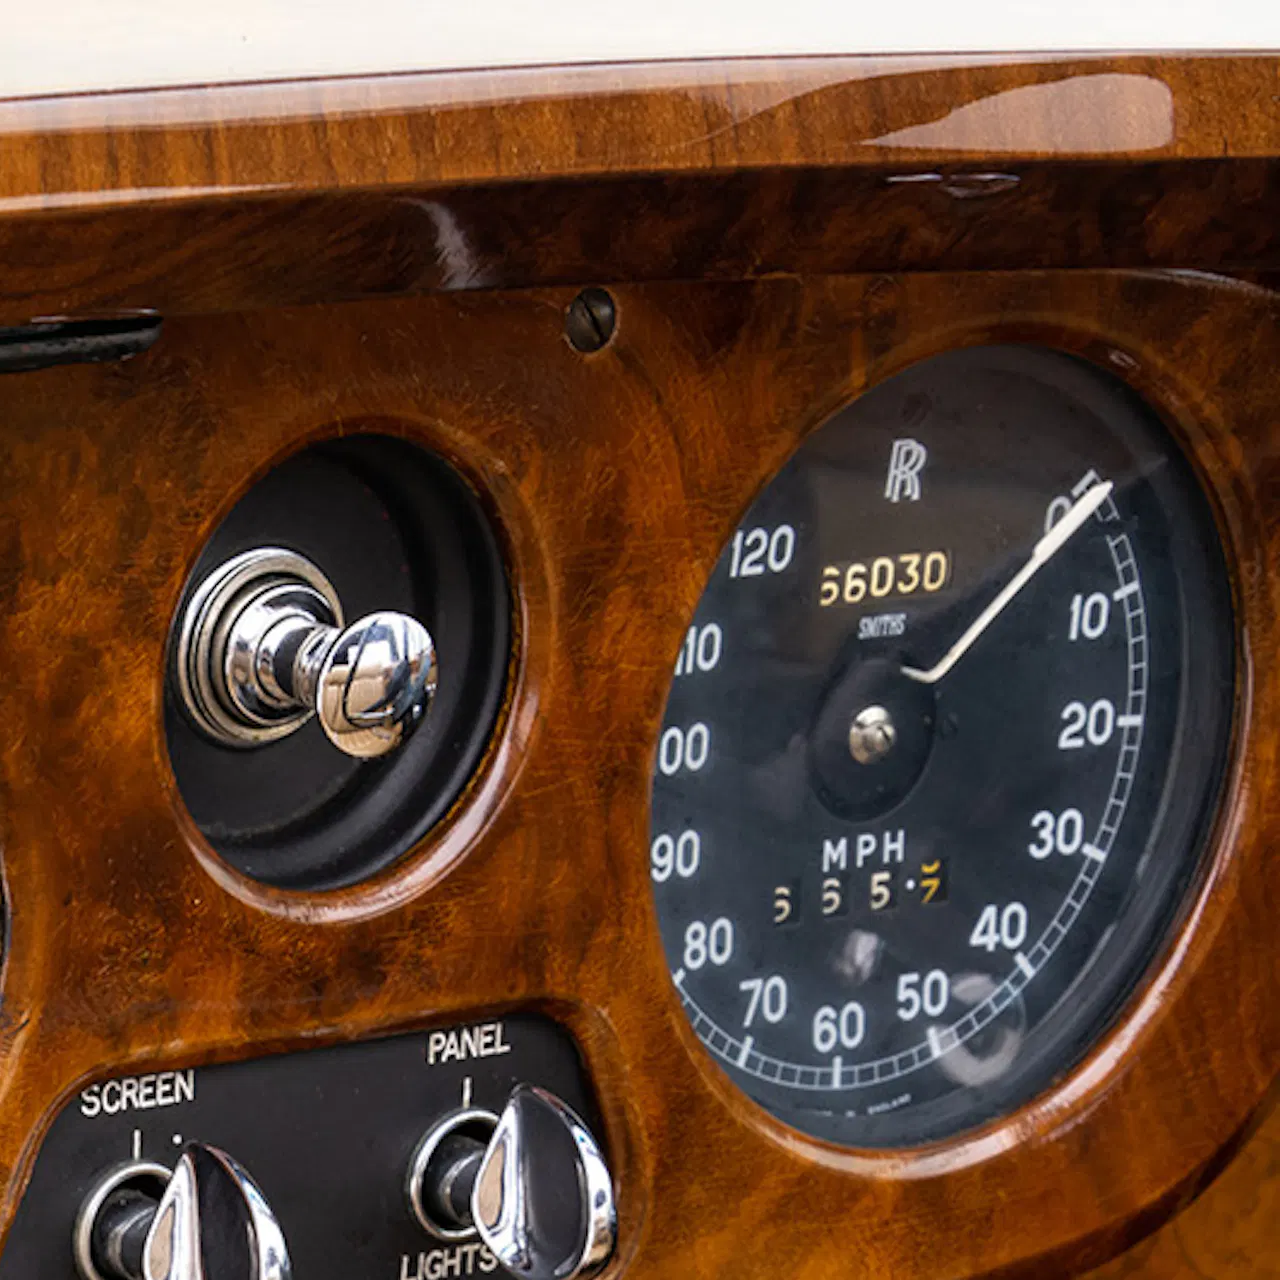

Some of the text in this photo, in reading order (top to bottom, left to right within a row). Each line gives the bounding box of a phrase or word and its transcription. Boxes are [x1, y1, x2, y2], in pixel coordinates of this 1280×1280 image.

[729, 524, 795, 578] 120
[857, 613, 907, 640] SMITHS
[1068, 591, 1110, 641] 10
[659, 722, 710, 776] 00
[1057, 698, 1115, 750] 20
[650, 829, 700, 882] 90
[822, 829, 906, 873] MPH
[1028, 808, 1084, 860] 30
[683, 916, 733, 970] 80
[970, 901, 1028, 952] 40
[739, 975, 787, 1027] 70
[896, 969, 950, 1020] 50
[427, 1023, 511, 1065] PANEL
[813, 1001, 864, 1053] 60
[80, 1069, 196, 1118] SCREEN
